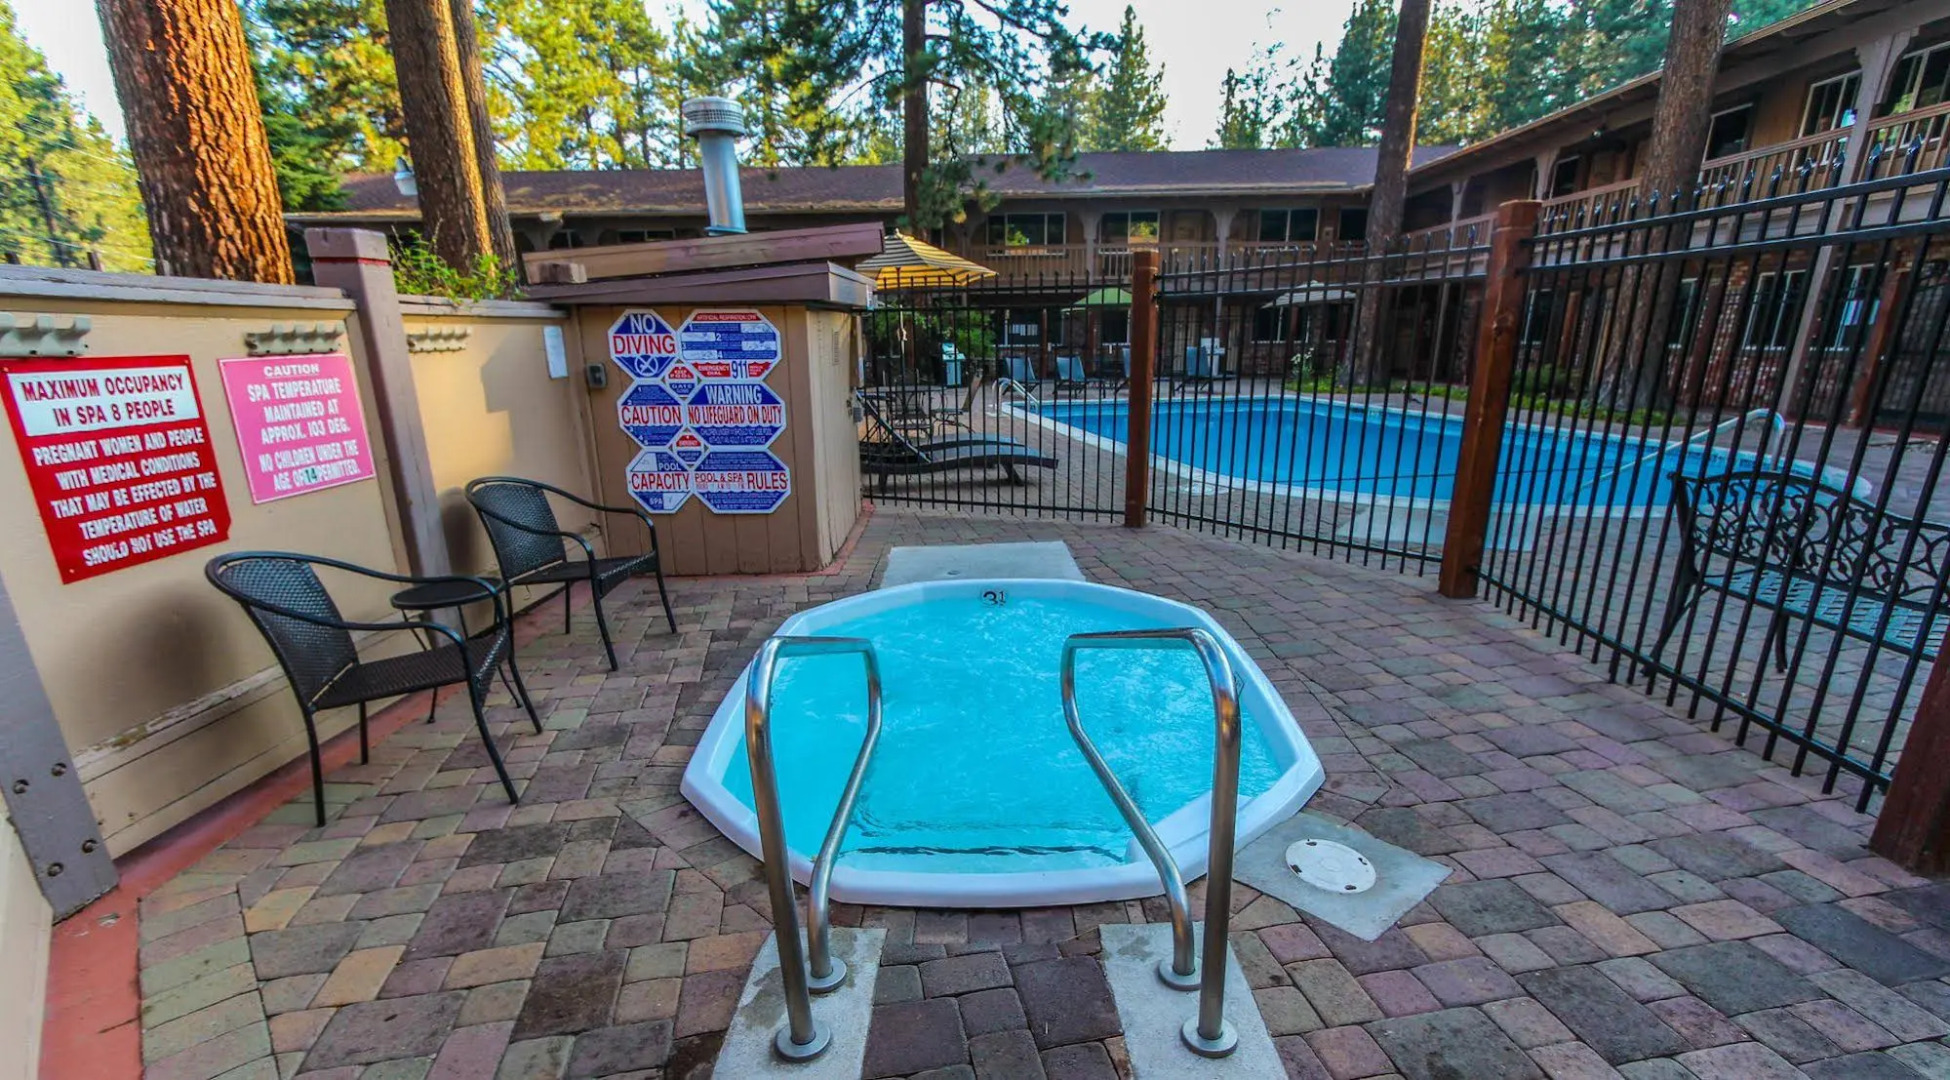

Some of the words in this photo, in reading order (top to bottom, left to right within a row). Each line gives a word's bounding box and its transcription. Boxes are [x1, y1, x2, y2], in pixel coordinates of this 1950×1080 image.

[630, 314, 656, 333] NO
[613, 335, 675, 354] DIVING
[264, 364, 320, 377] CAUTION
[732, 361, 748, 378] 911
[21, 378, 101, 401] MAXIMUM
[105, 374, 184, 395] OCCUPANCY
[247, 384, 270, 402] SPA
[271, 378, 341, 399] TEMPERATURE
[706, 385, 762, 404] WARNING
[53, 408, 71, 427] IN
[77, 405, 107, 424] SPA
[112, 404, 121, 421] 8
[126, 399, 174, 419] PEOPLE
[264, 401, 324, 423] MAINTAINED
[328, 399, 339, 414] AT
[621, 406, 681, 424] CAUTION
[688, 406, 701, 423] NO
[703, 406, 744, 423] LIFEGUARD
[747, 406, 759, 423] ON
[762, 406, 782, 423] DUTY
[261, 423, 306, 444] APPROX.
[308, 420, 325, 437] 103
[328, 418, 350, 433] DEG.
[33, 440, 98, 465] PREGNANT
[100, 434, 142, 456] WOMEN
[145, 432, 165, 449] AND
[167, 427, 204, 445] PEOPLE
[259, 454, 273, 472] NO
[274, 447, 316, 469] CHILDREN
[316, 443, 343, 461] UNDER
[343, 440, 359, 456] THE
[56, 469, 89, 490] WITH
[90, 461, 140, 485] MEDICAL
[141, 452, 200, 476] CONDITIONS
[273, 472, 292, 491] AGE
[632, 473, 689, 490] CAPACITY
[695, 473, 717, 482] POOL
[720, 473, 726, 482] &
[728, 473, 742, 482] SPA
[747, 473, 788, 489] RULES
[50, 498, 84, 518] THAT
[85, 492, 111, 511] MAY
[113, 488, 130, 506] BE
[133, 479, 180, 503] EFFECTED
[182, 476, 196, 492] BY
[197, 472, 216, 489] THE
[79, 508, 158, 539] TEMPERATURE
[159, 505, 173, 522] OF
[174, 498, 207, 517] WATER
[83, 542, 129, 566] SHOULD
[131, 535, 153, 554] NOT
[153, 529, 175, 547] USE
[176, 524, 196, 541] THE
[197, 519, 217, 536] SPA
